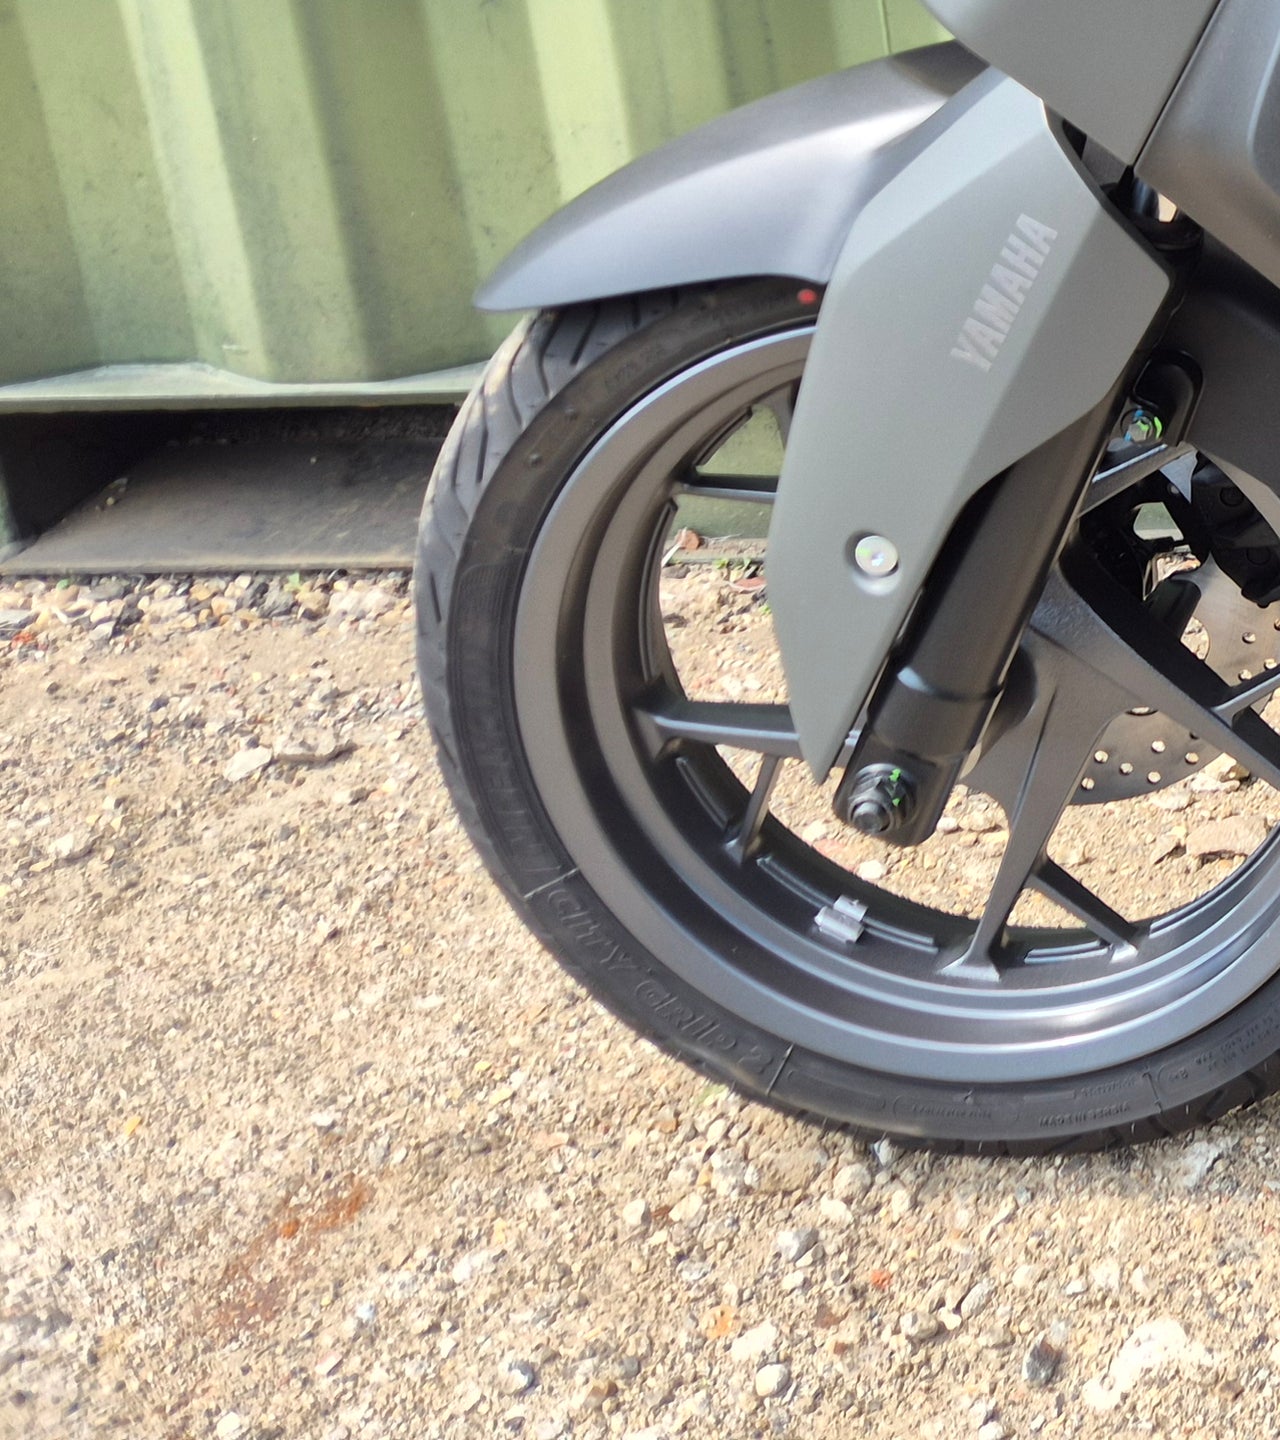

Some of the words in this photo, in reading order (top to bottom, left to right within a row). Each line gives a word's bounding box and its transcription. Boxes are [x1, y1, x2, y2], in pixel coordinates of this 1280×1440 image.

[950, 213, 1058, 373] YAMAHA
[548, 887, 639, 972] CITY
[633, 978, 737, 1052] GRIP
